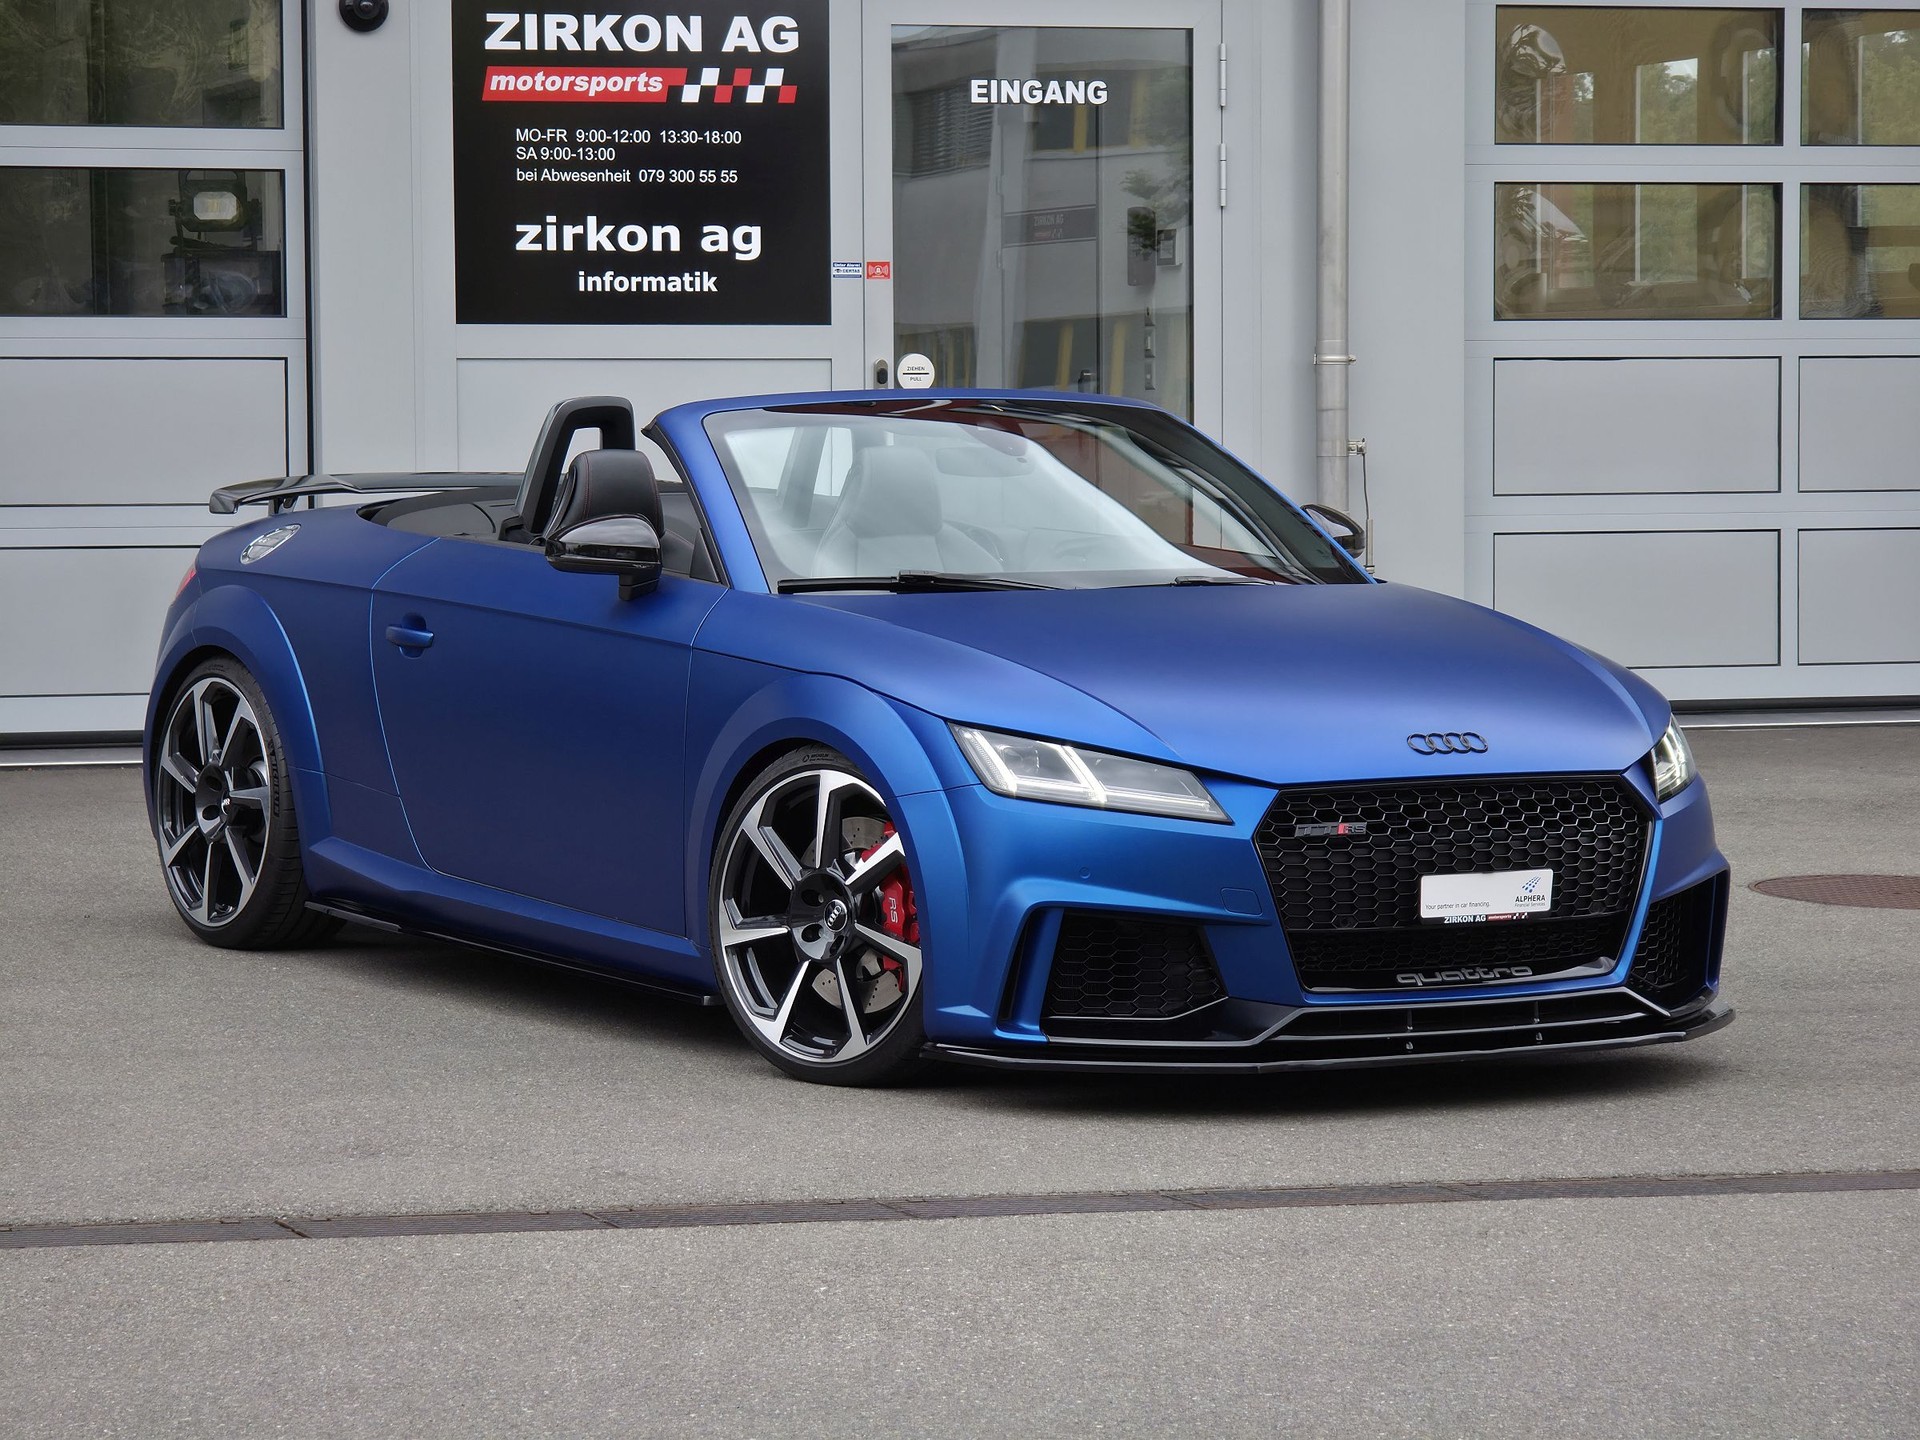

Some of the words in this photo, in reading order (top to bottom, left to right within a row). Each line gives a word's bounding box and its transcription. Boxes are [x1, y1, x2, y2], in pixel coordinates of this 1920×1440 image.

[485, 13, 702, 52] ZIRKON
[721, 16, 799, 53] AG
[490, 71, 663, 96] motorsports
[972, 80, 1107, 104] EINGANG
[517, 129, 567, 142] MO-FR
[576, 129, 650, 143] 9:00-12:00
[660, 130, 741, 144] 13:30-18:00
[517, 147, 537, 159] SA
[541, 147, 615, 160] 9:00-13:00
[517, 168, 537, 181] bei
[541, 169, 630, 182] Abwesenheit
[639, 170, 664, 182] 079
[669, 170, 695, 182] 300
[699, 170, 716, 183] 55
[721, 170, 737, 183] 55
[516, 216, 680, 252] zirkon
[701, 225, 761, 260] ag
[579, 271, 718, 292] informatik
[1515, 894, 1546, 903] ALPHERA
[889, 897, 898, 923] RS
[1444, 915, 1474, 924] ZIRKON
[1475, 914, 1487, 922] AG
[1396, 966, 1533, 986] quattro
